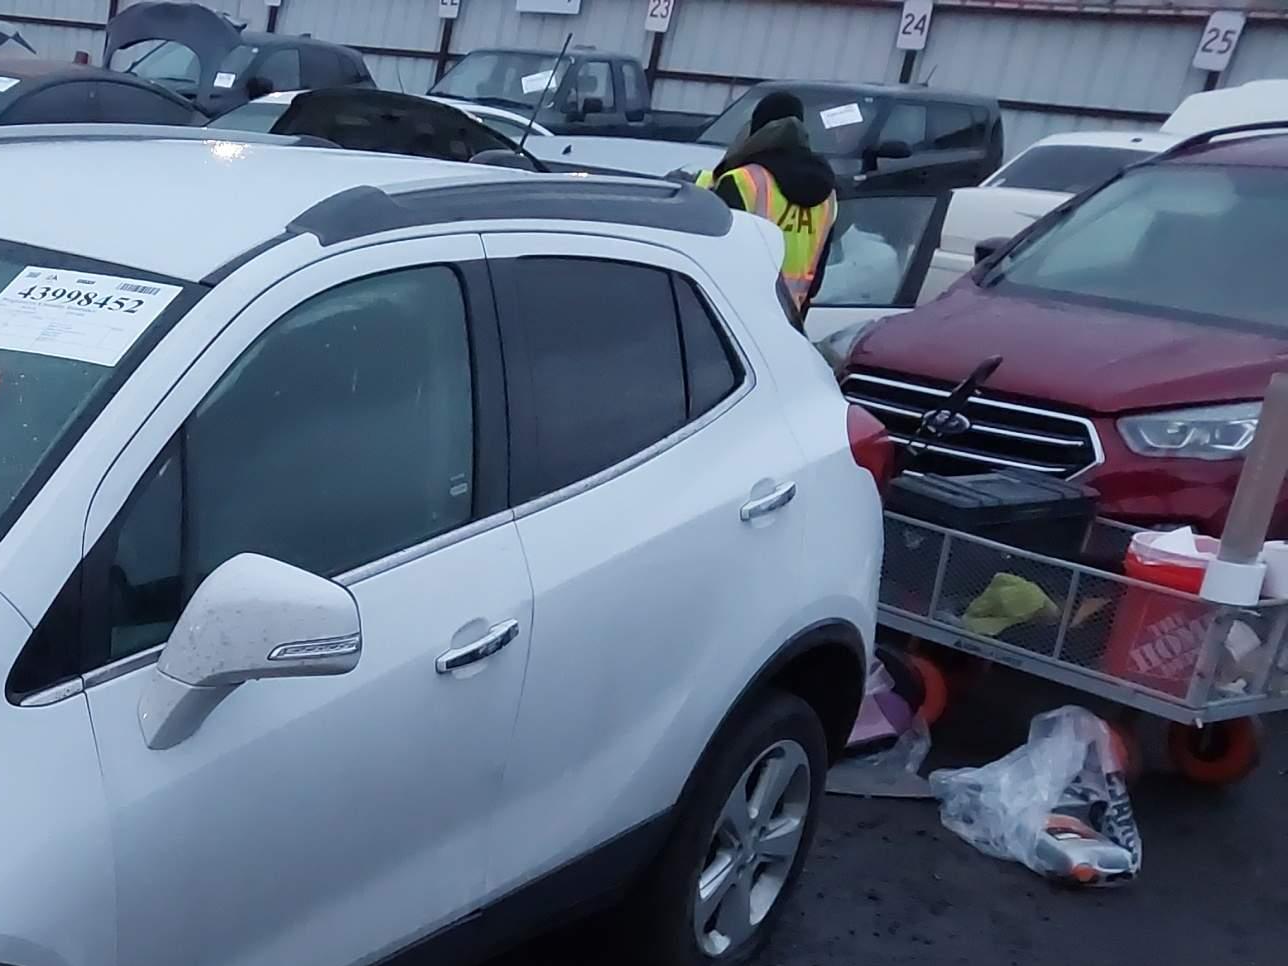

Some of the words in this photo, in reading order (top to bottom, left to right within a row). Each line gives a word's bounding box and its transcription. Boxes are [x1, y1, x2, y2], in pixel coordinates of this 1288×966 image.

[649, 0, 670, 18] 23
[902, 13, 928, 36] 24
[1201, 27, 1236, 54] 25
[17, 284, 145, 314] 43998452
